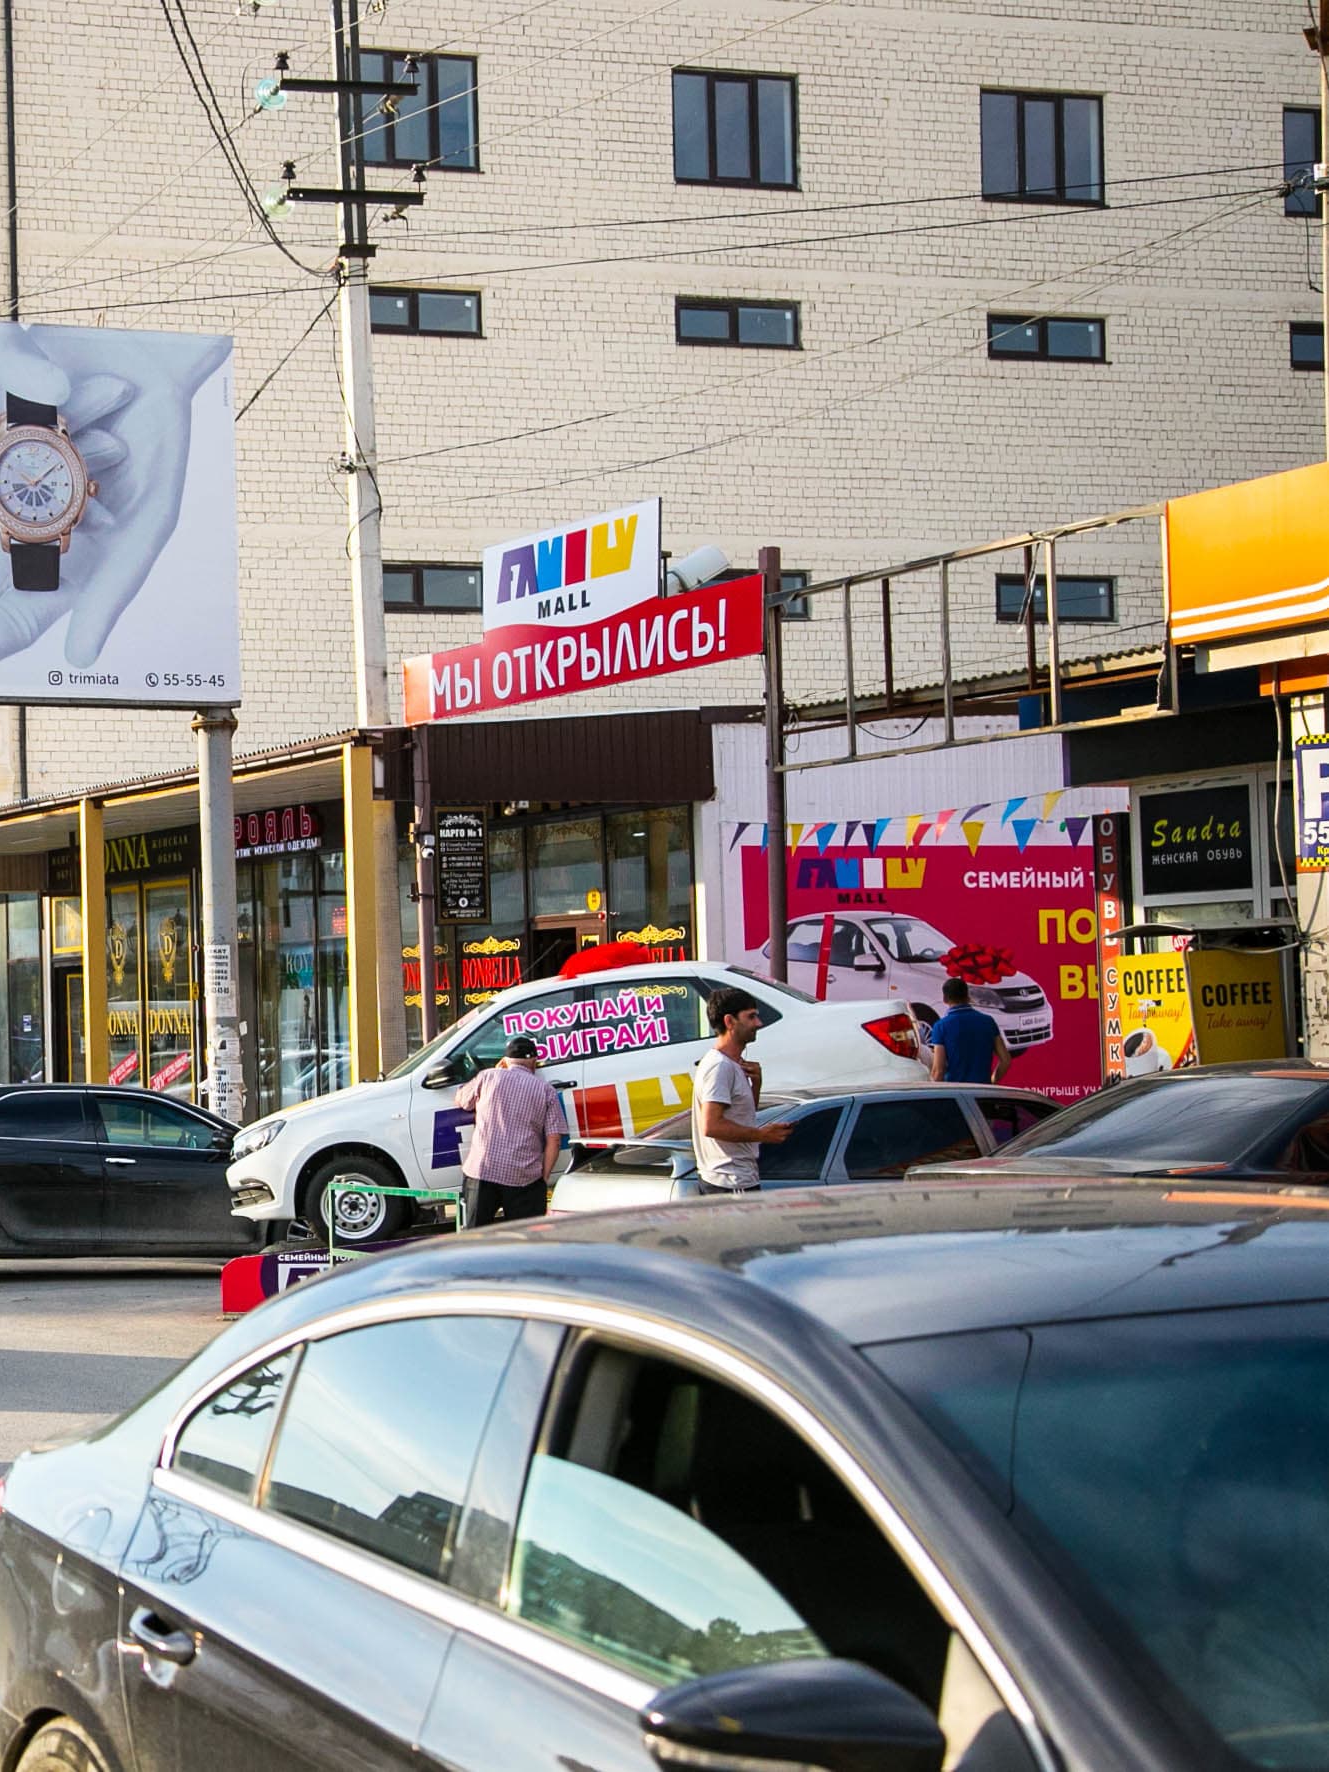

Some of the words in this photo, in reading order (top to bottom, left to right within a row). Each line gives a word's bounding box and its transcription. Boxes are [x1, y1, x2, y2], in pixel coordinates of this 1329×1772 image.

[497, 514, 638, 604] FAMILY
[537, 589, 591, 620] MALL
[429, 658, 481, 713] МЫ
[493, 598, 727, 700] ОТКРЫЛИСЬ!
[70, 673, 119, 685] trimiata
[164, 673, 225, 687] 55-55-45
[439, 829, 465, 837] КАРГО
[1151, 816, 1243, 847] Sandra
[104, 834, 150, 873] ONNA
[235, 848, 251, 858] УТИК
[254, 843, 285, 855] МУЖСКОЙ
[287, 837, 321, 851] ОДЕЖДЫ
[1152, 849, 1198, 865] ЖЕНСКАЯ
[1206, 847, 1243, 861] ОБУВЬ
[963, 867, 1084, 889] СЕМЕЙНЫЙ
[837, 893, 887, 904] MALL
[462, 956, 522, 989] BONBELLA
[1123, 967, 1185, 997] COFFEE
[1201, 981, 1272, 1008] COFFEE
[108, 1010, 138, 1035] ONNA
[150, 1008, 190, 1034] DONNA
[503, 988, 640, 1036] ПОКУПАЙ
[1206, 1013, 1233, 1029] Take
[1236, 1010, 1272, 1030] away!
[535, 1015, 670, 1062] ЫИГРАЙ!
